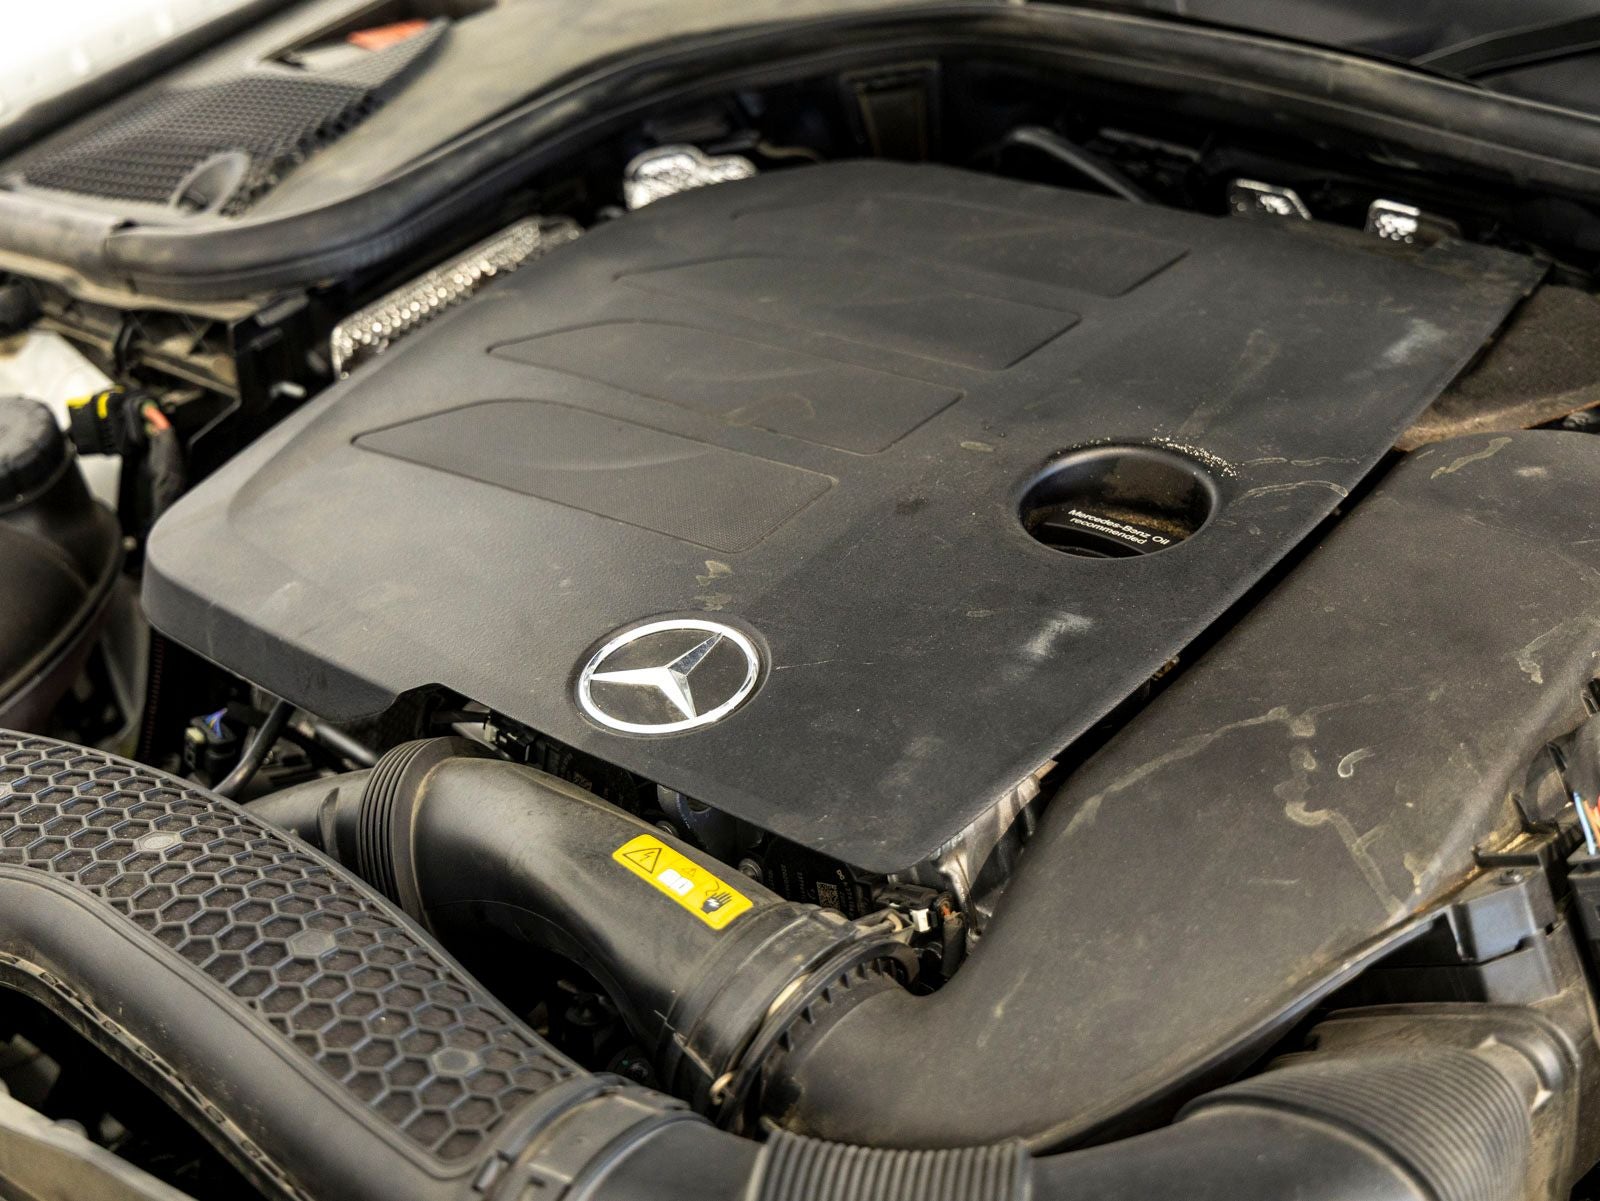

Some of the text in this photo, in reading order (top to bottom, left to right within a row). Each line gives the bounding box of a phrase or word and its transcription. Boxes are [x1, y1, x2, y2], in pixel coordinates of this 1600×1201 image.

[1068, 509, 1170, 545] Mercedes-Benz Oil
[1070, 517, 1147, 545] recommended
